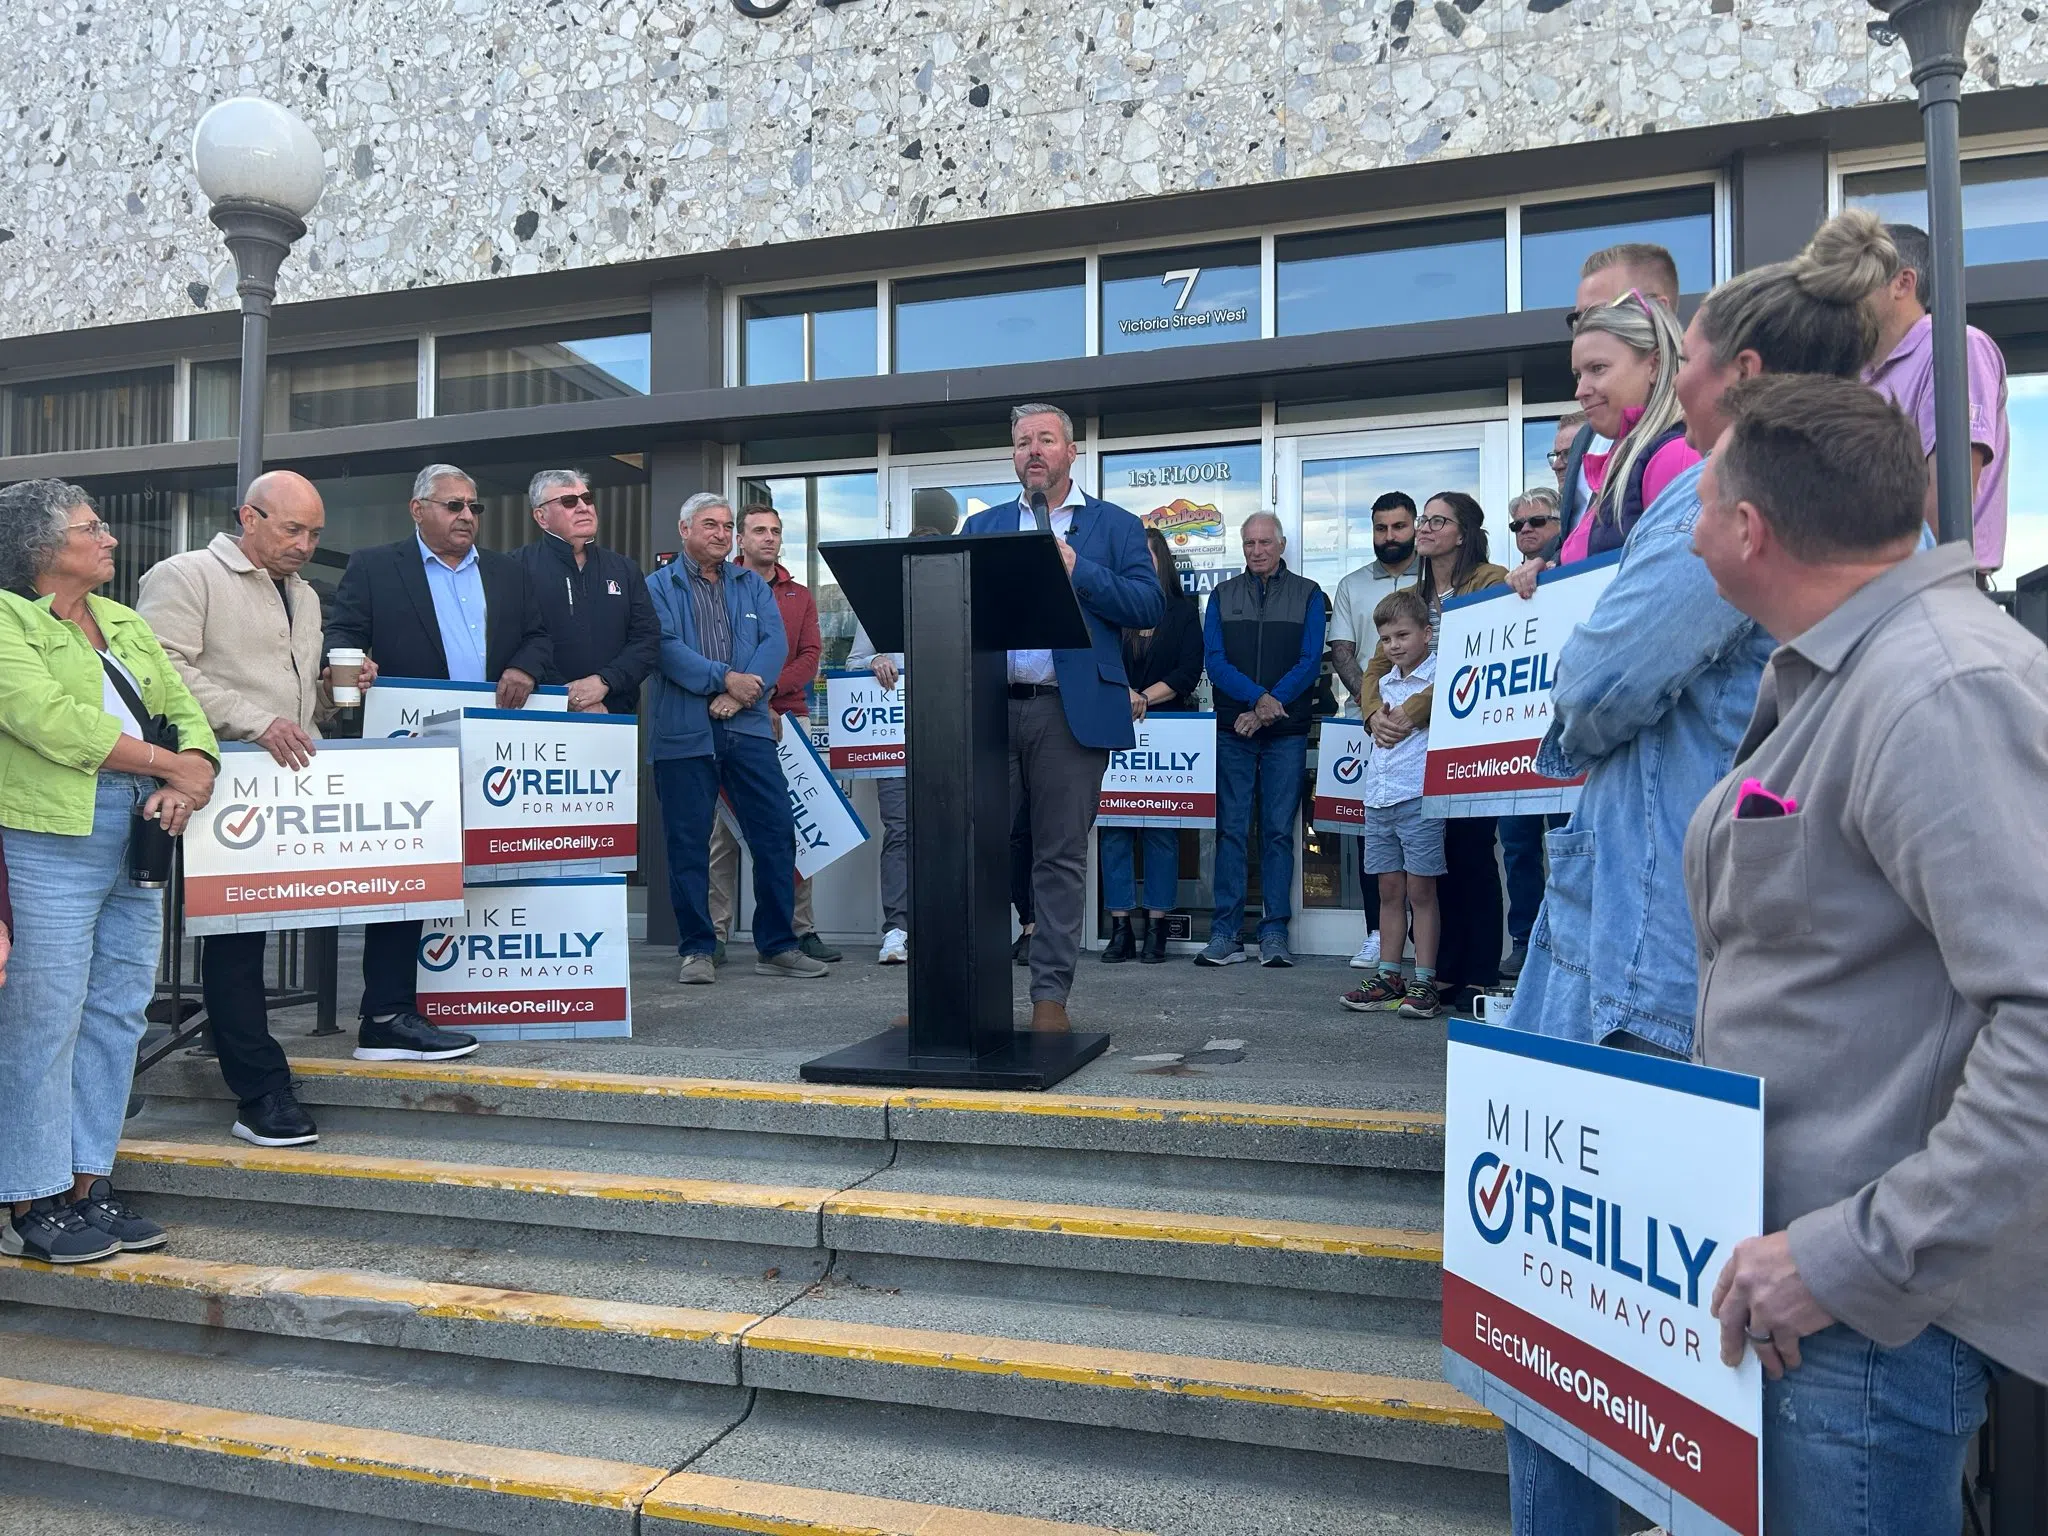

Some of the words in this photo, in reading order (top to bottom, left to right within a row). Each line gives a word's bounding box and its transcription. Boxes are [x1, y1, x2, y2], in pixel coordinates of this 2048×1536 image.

[1161, 267, 1201, 310] 7
[1119, 318, 1169, 333] Victoria
[1172, 311, 1210, 327] Street
[1213, 307, 1247, 322] West
[1129, 470, 1155, 486] 1st
[1159, 462, 1231, 484] FLOOR
[1141, 508, 1222, 530] Kamloops
[1465, 617, 1539, 659] MIKE
[850, 689, 906, 704] MIKE
[1448, 652, 1552, 719] O'REIL
[841, 706, 904, 733] O'RE
[1482, 707, 1514, 725] FOR
[872, 728, 896, 737] FOR
[496, 742, 567, 762] MIKE
[848, 750, 906, 762] ElectMikeO
[1111, 751, 1200, 771] REILLY
[776, 744, 818, 801] MIKE
[1111, 774, 1137, 783] FOR
[1145, 775, 1194, 784] MAYOR
[1447, 755, 1537, 780] ElectMikeOR
[234, 774, 345, 799] MIKE
[482, 766, 621, 807] O'REILLY
[523, 803, 553, 814] FOR
[562, 801, 615, 812] MAYOR
[1099, 798, 1194, 811] ctMikeOReilly.ca
[213, 800, 434, 850] O'REILLY
[277, 843, 325, 856] FOR
[340, 837, 424, 853] MAYOR
[489, 835, 615, 853] ElectMikeOReilly.ca
[226, 877, 426, 902] ElectMikeOReilly.ca
[417, 931, 604, 972] O'REILLY
[468, 967, 508, 978] FOR
[521, 965, 594, 977] MAYOR
[426, 1000, 594, 1016] ElectMikeOReilly.ca
[1488, 1099, 1601, 1176] MIKE
[1468, 1151, 1719, 1307] O'REILLY
[1523, 1252, 1574, 1299] FOR
[1591, 1282, 1701, 1363] MAYOR
[1475, 1312, 1702, 1473] ElectMikeOReilly.ca
